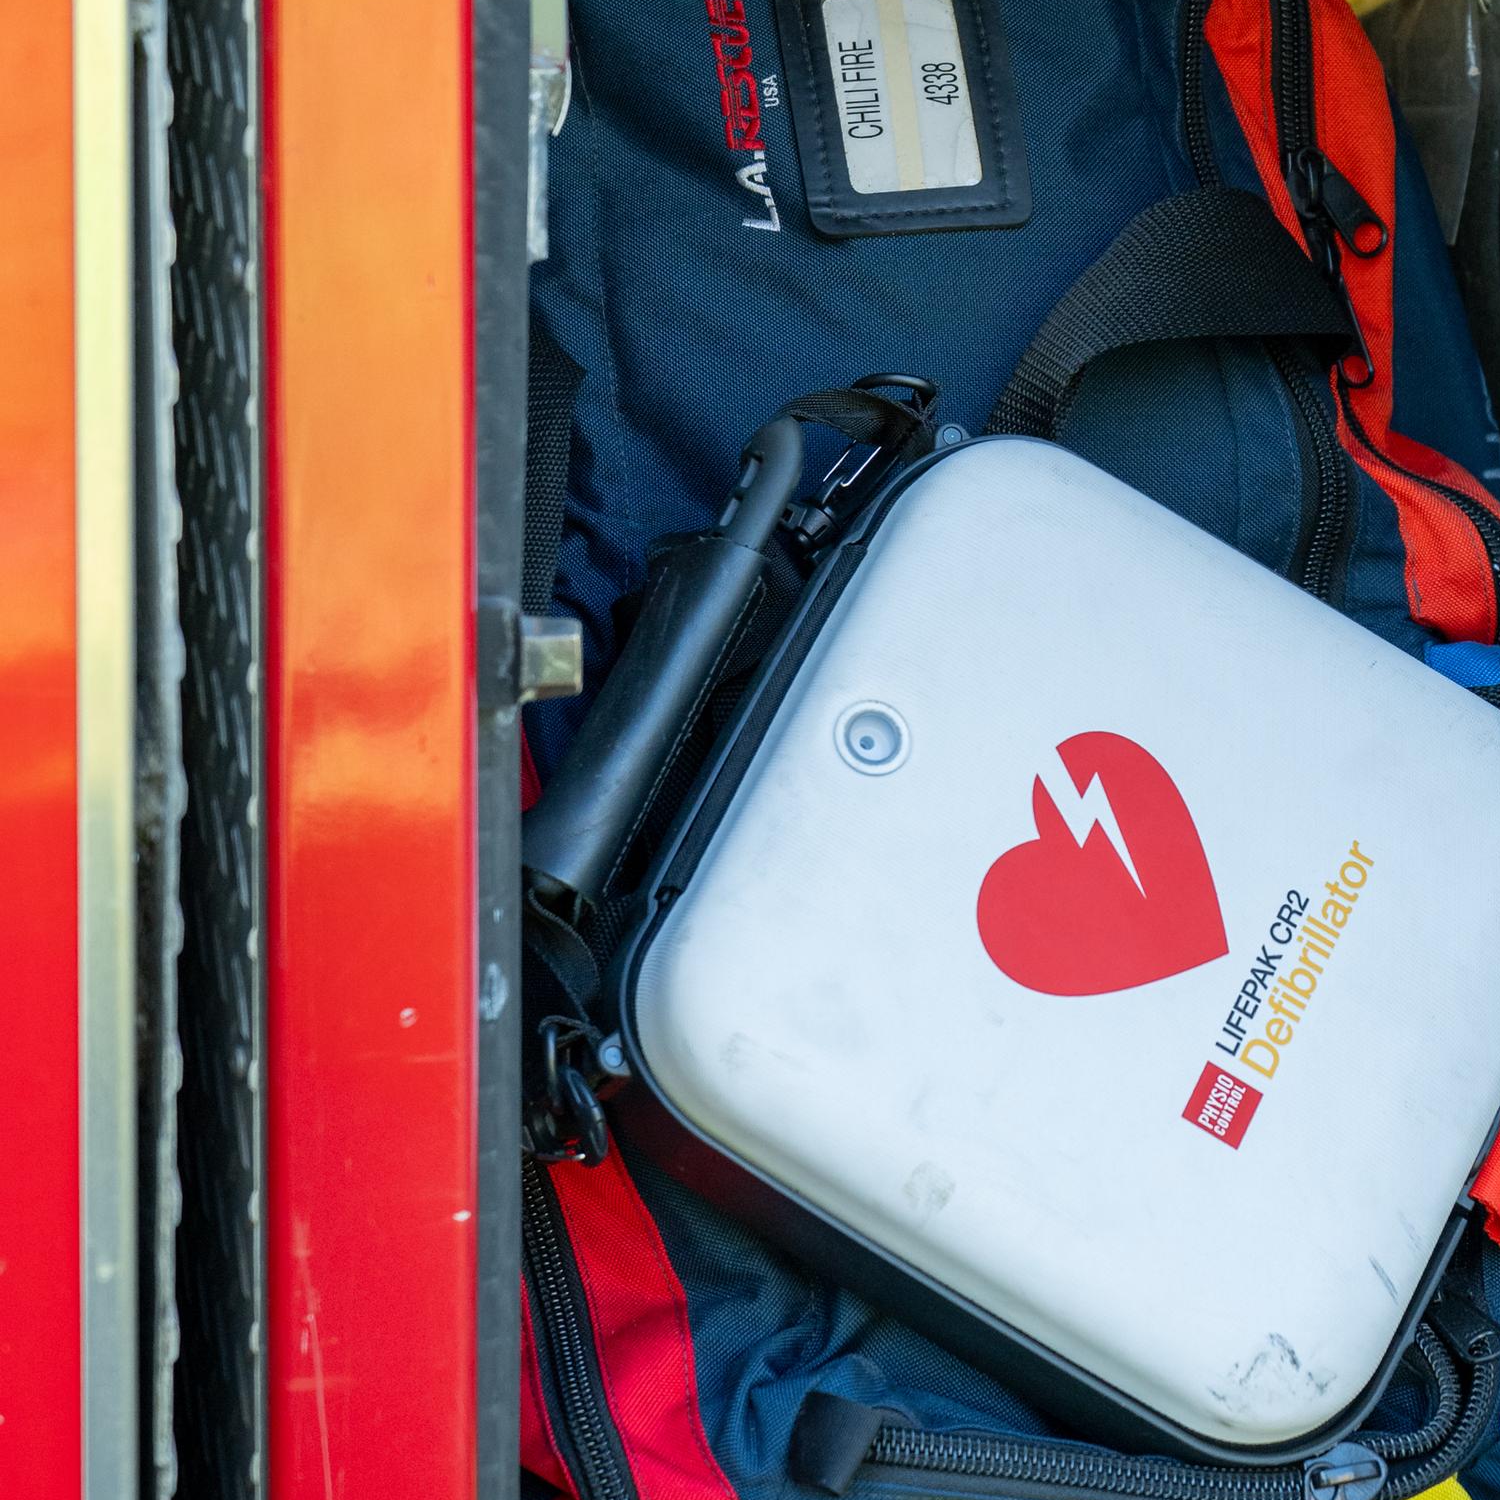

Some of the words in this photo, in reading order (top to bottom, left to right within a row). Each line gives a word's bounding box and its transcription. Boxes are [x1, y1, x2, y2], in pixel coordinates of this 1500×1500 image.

[838, 39, 877, 83] FIRE
[921, 62, 960, 105] 4338
[762, 74, 779, 108] USA
[844, 88, 884, 139] CHILI
[1214, 944, 1283, 1057] LIFEPAK
[1269, 889, 1310, 945] CR2
[1238, 839, 1375, 1079] Defibrillator
[1197, 1073, 1234, 1130] PHYSIO
[1212, 1084, 1246, 1137] CONTROL
